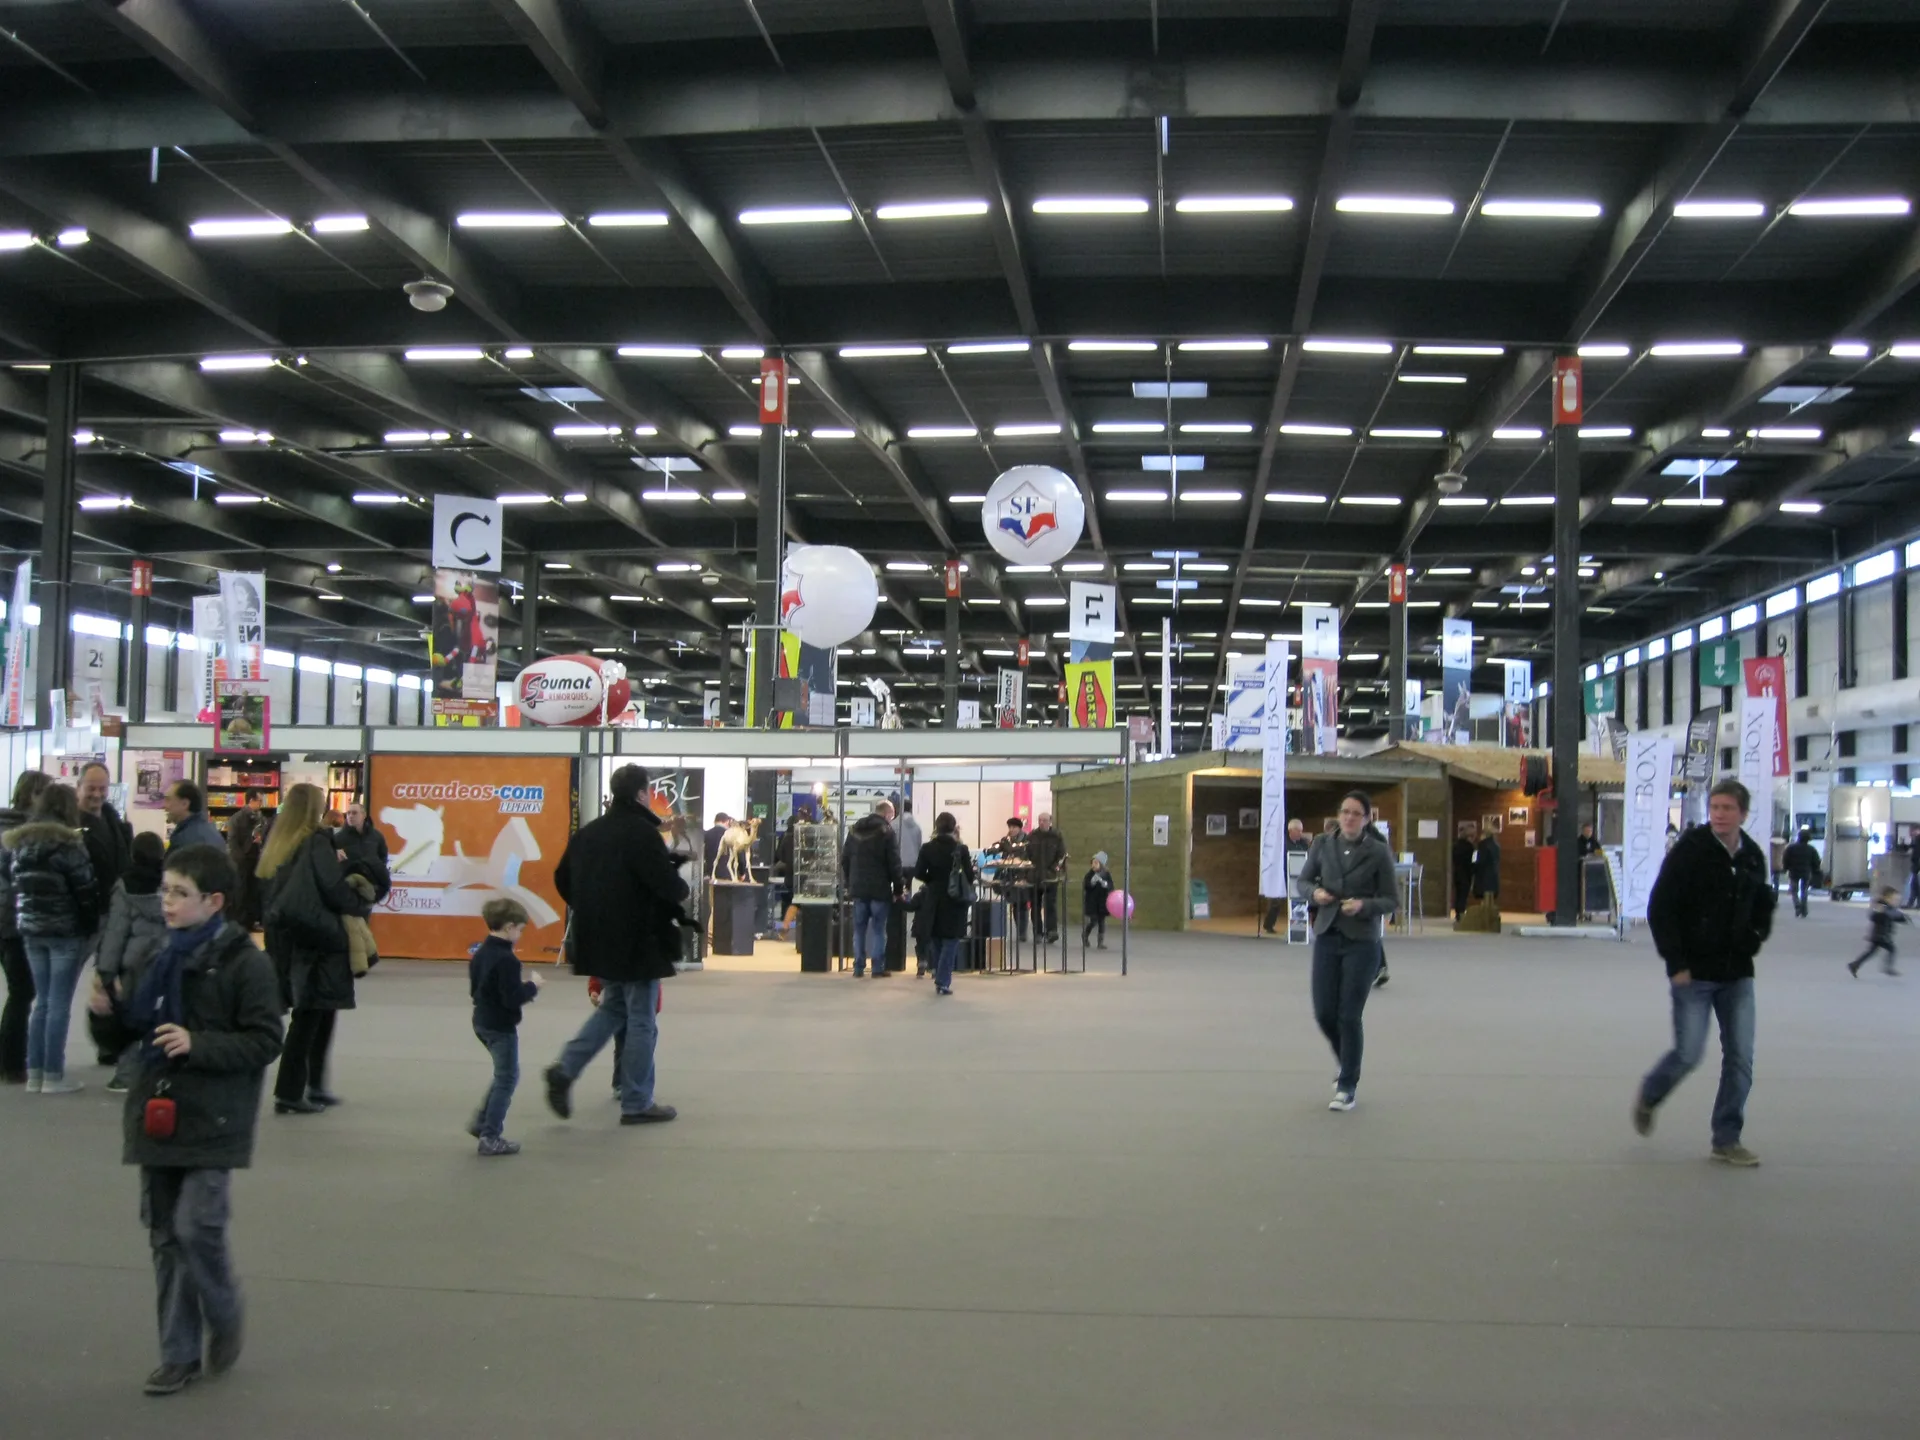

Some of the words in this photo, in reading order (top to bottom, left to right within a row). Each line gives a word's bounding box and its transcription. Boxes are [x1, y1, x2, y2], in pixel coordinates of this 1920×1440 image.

[1010, 496, 1040, 515] SF
[450, 512, 491, 566] C
[523, 674, 592, 703] Soumat
[392, 780, 544, 801] cavadeos.com
